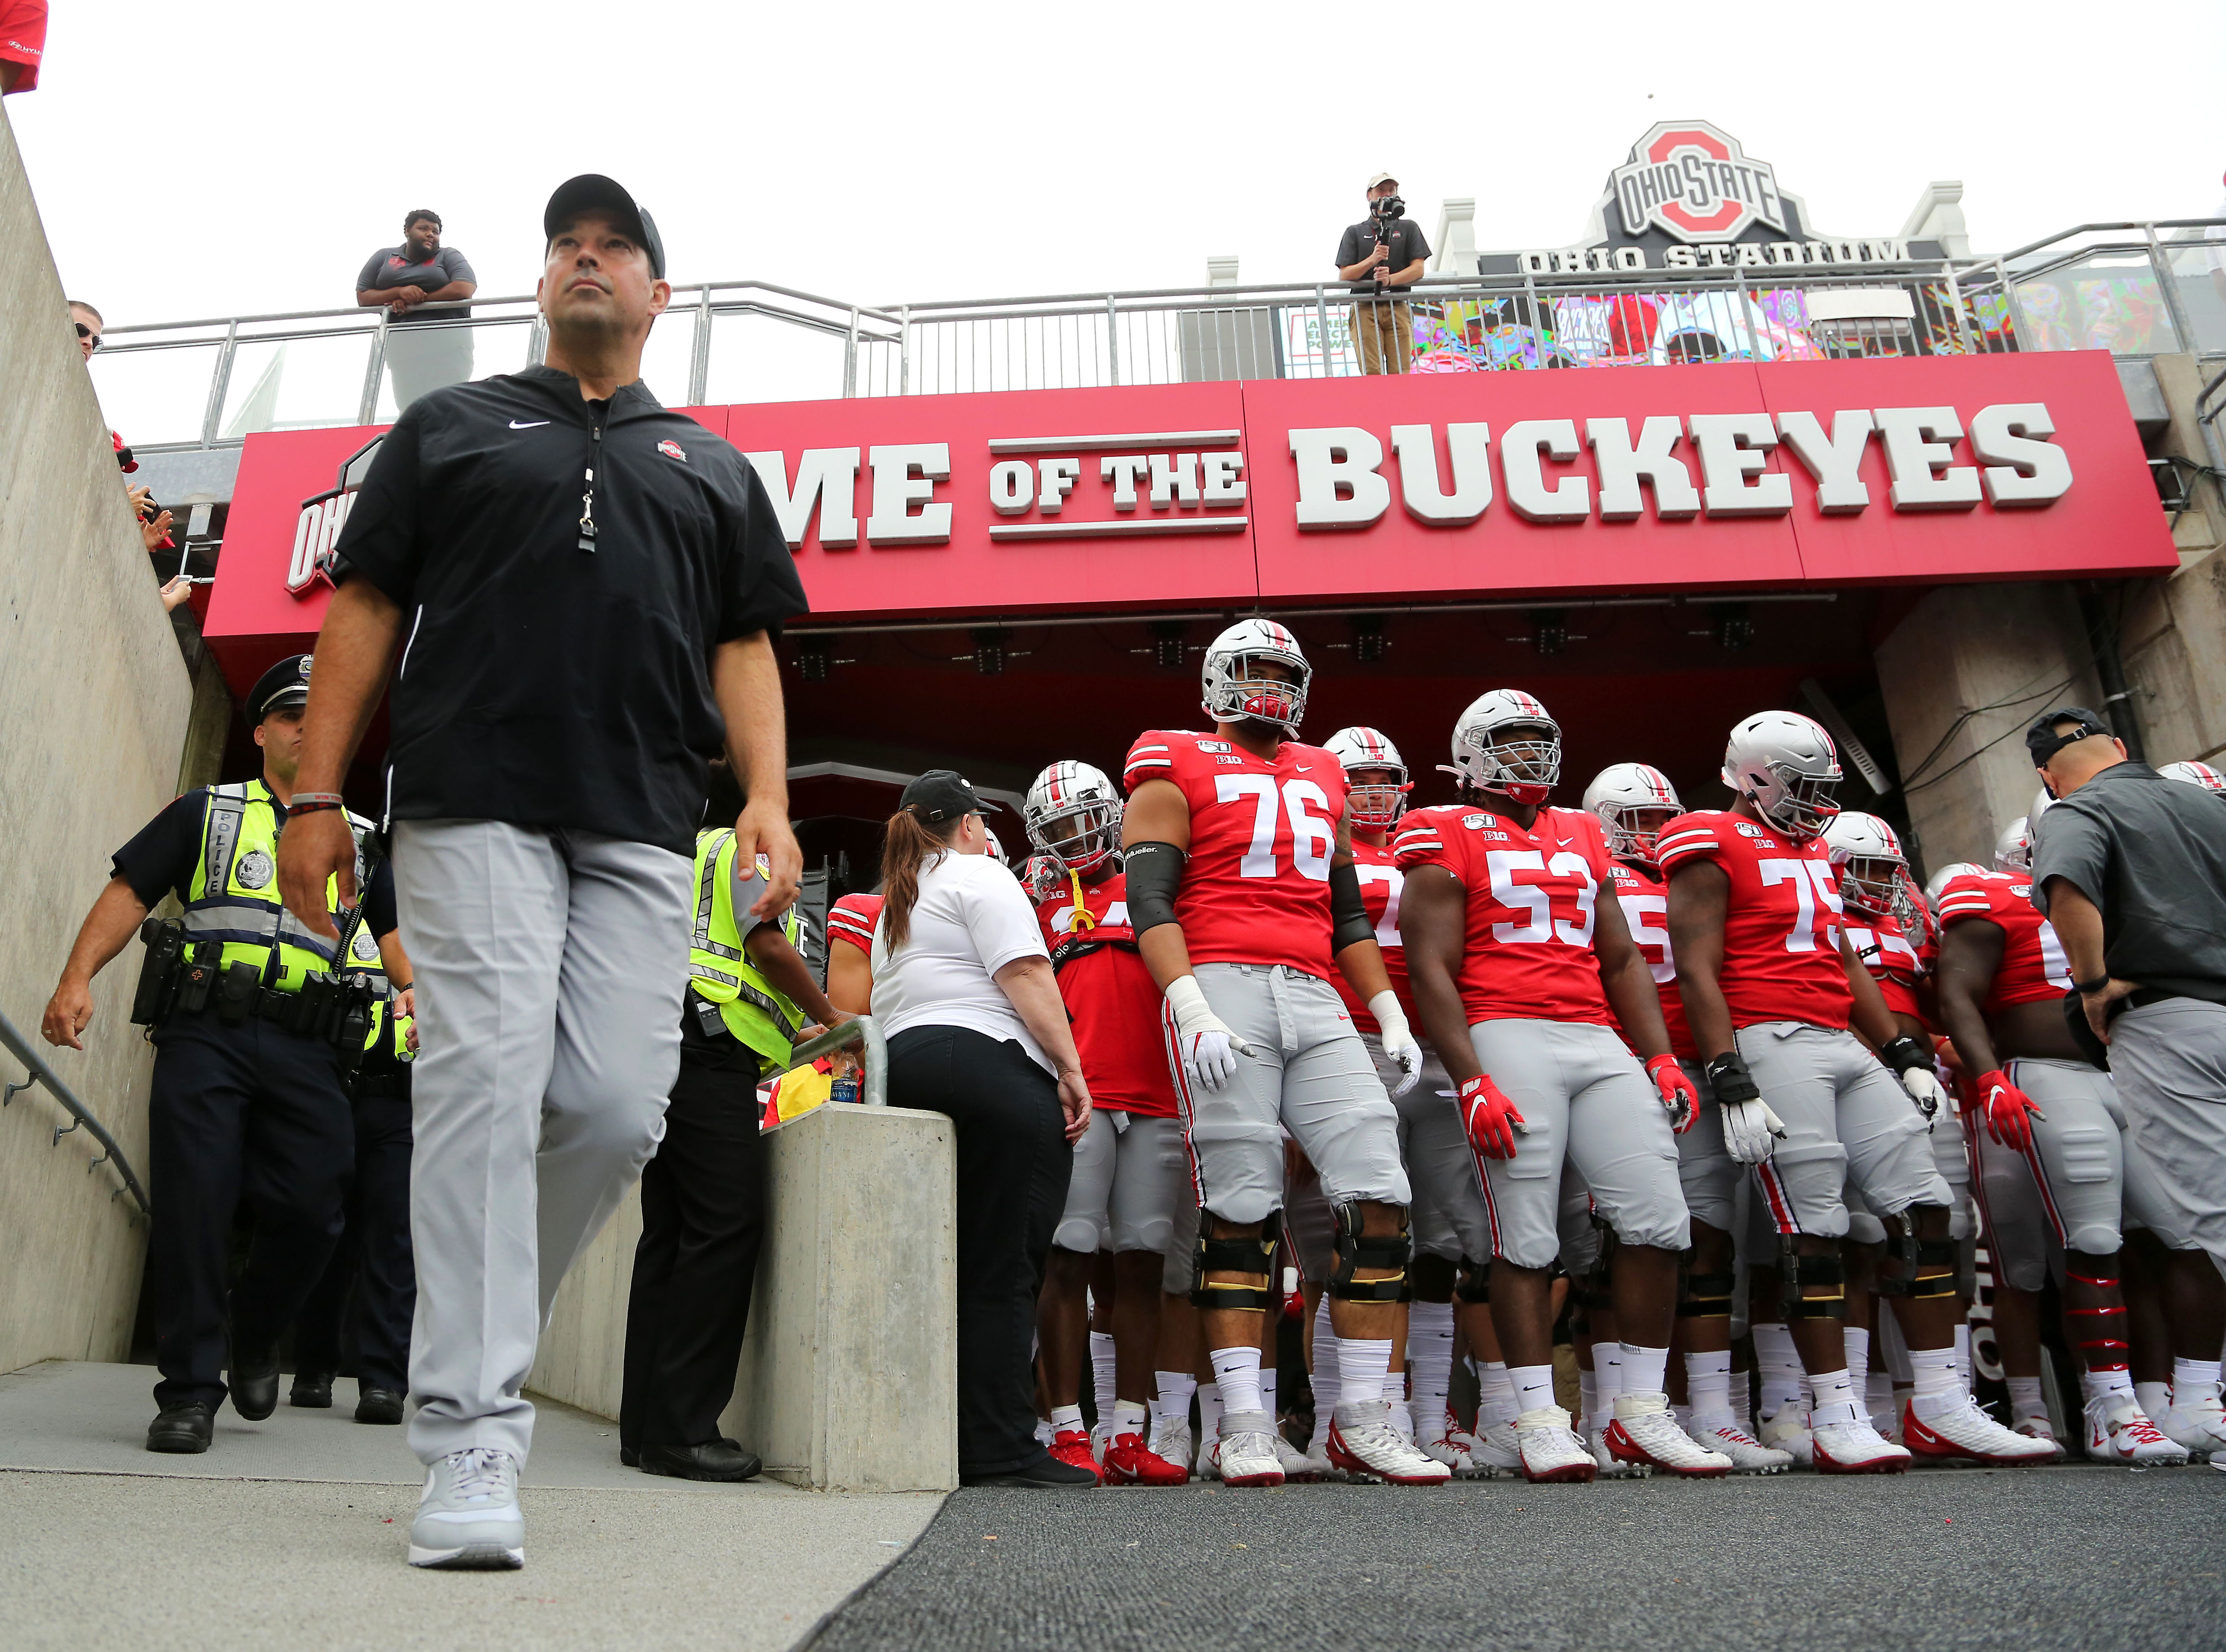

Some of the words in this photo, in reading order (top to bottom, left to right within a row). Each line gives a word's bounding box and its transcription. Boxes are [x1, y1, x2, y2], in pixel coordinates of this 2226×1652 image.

[1621, 163, 1684, 229] OHIO
[1681, 155, 1781, 225] STATE
[1517, 246, 1647, 273] OHIO
[1663, 238, 1913, 269] STADIUM
[990, 458, 1080, 515] OF
[1100, 451, 1248, 511] THE
[1288, 402, 2073, 532] BUCKEYES
[210, 813, 232, 893] POLICE
[1213, 773, 1336, 883] 76
[1485, 849, 1598, 948] 53
[1758, 857, 1844, 953] 75
